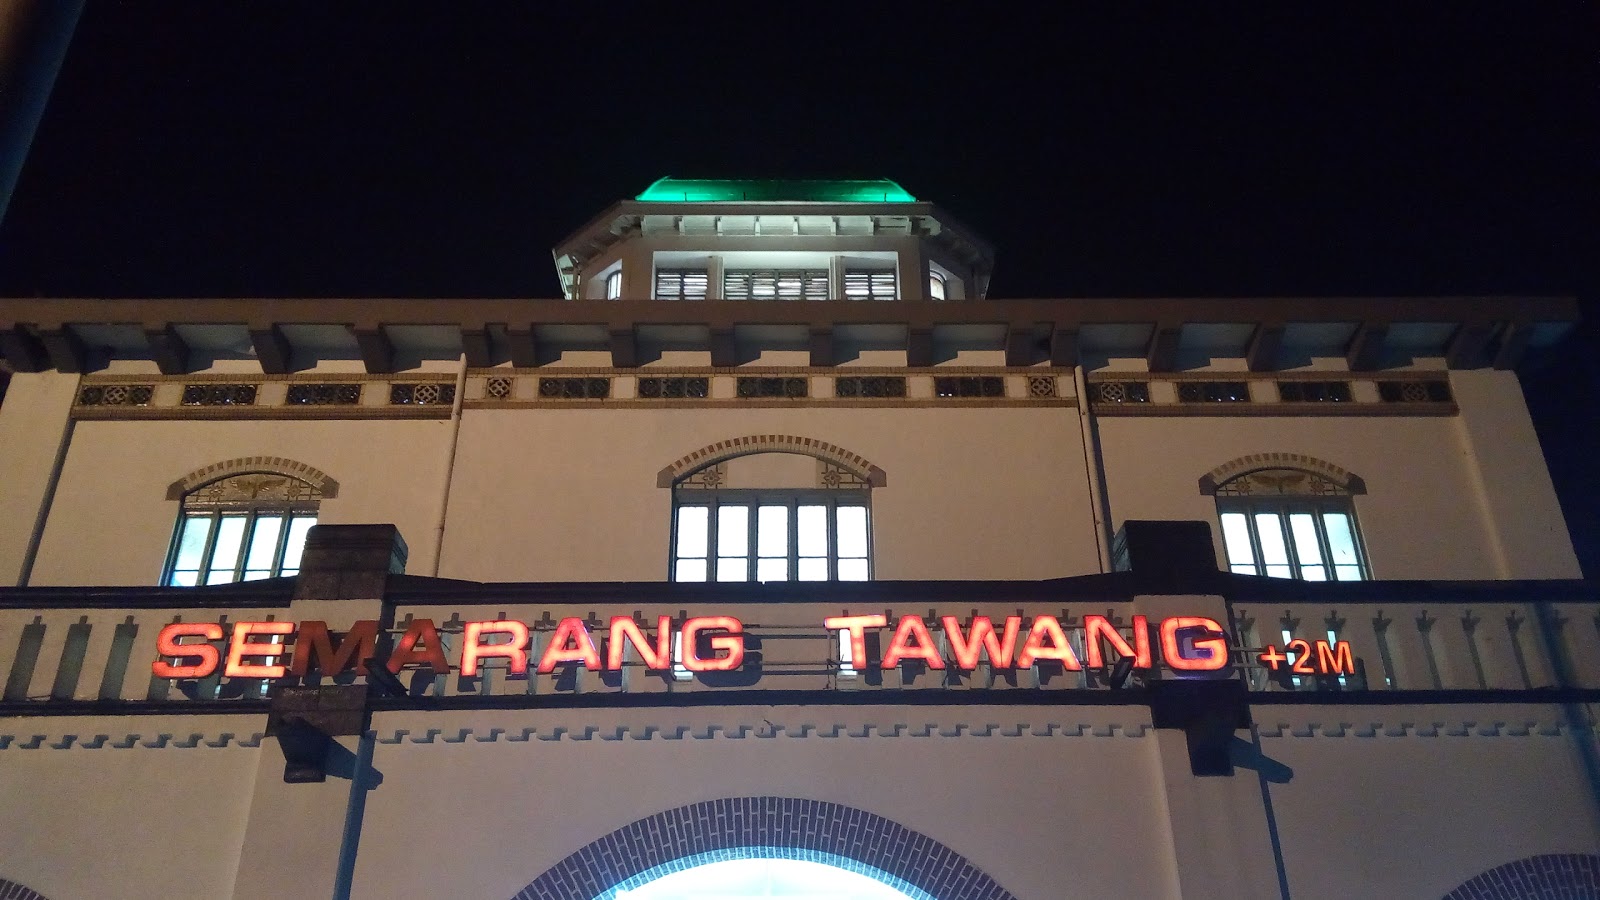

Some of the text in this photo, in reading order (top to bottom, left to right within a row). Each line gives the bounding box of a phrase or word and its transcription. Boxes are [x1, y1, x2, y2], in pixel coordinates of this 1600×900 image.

[151, 614, 1356, 679] SEMARANG TAWANG +2M
